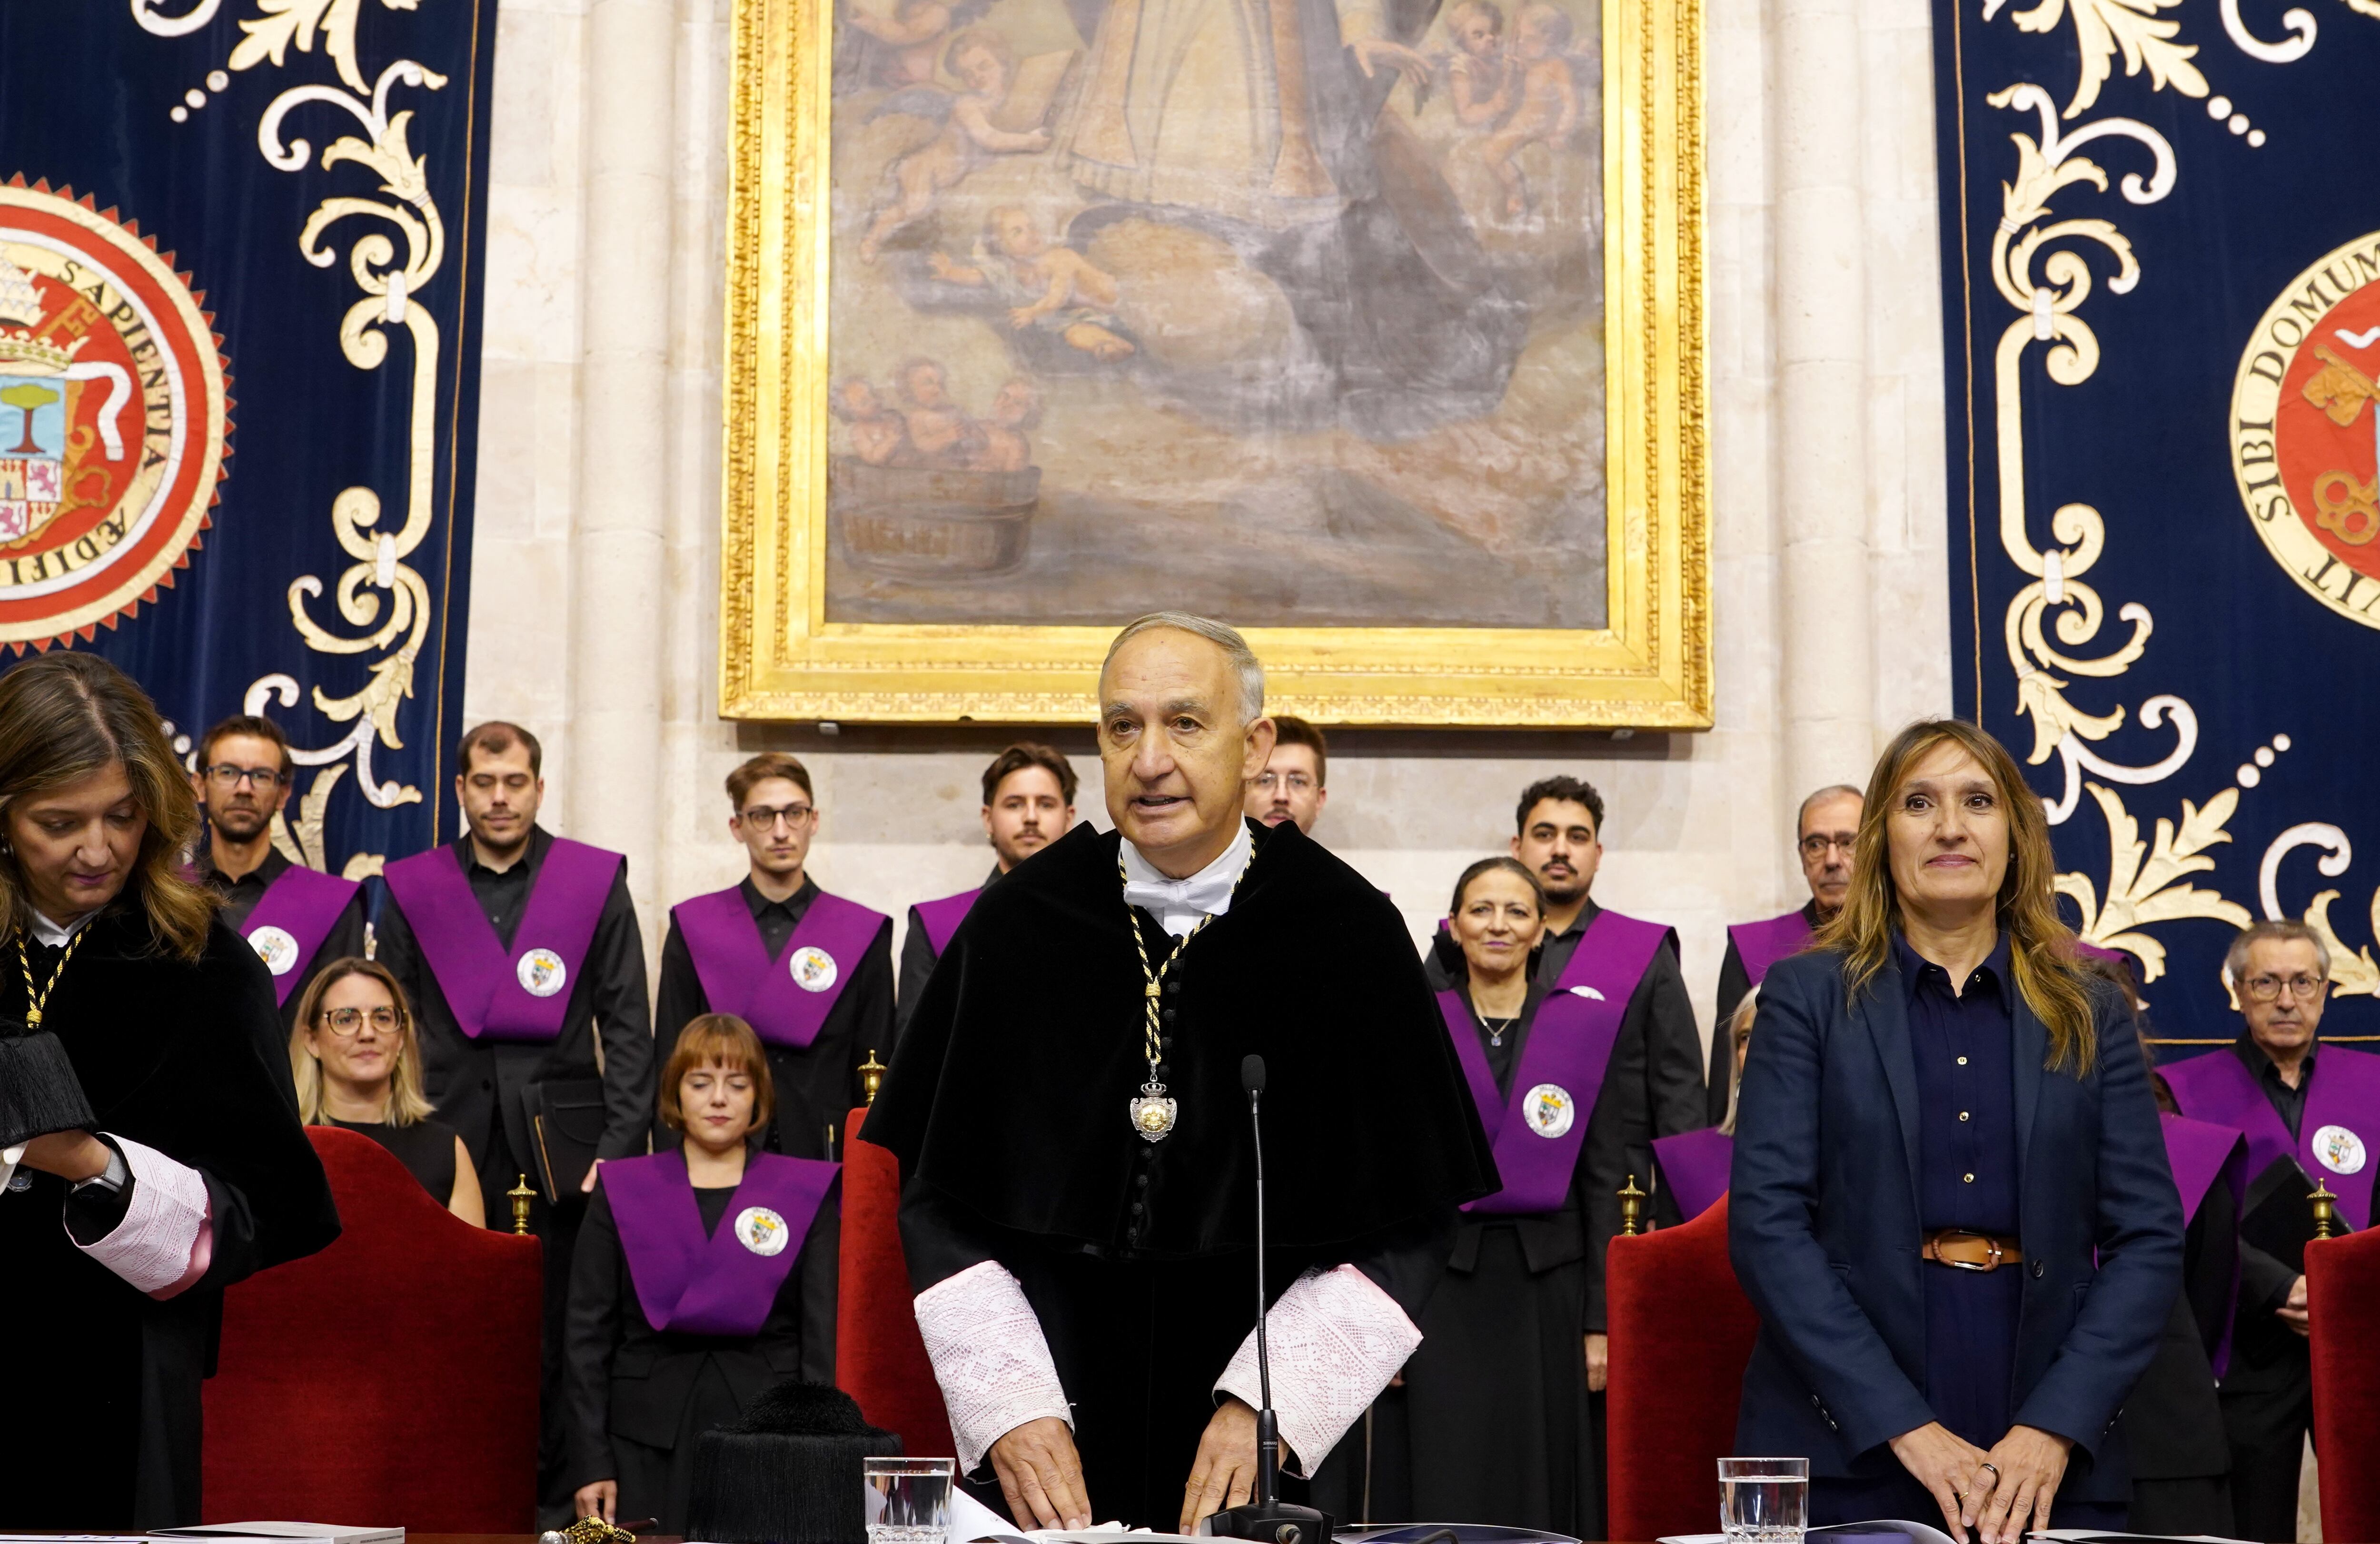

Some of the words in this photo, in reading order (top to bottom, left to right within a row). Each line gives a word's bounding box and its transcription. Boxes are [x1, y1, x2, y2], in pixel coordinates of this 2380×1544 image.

[58, 260, 171, 473] SAPIENTIA
[2249, 243, 2380, 386] DOMUM
[2239, 417, 2291, 522] SIBI
